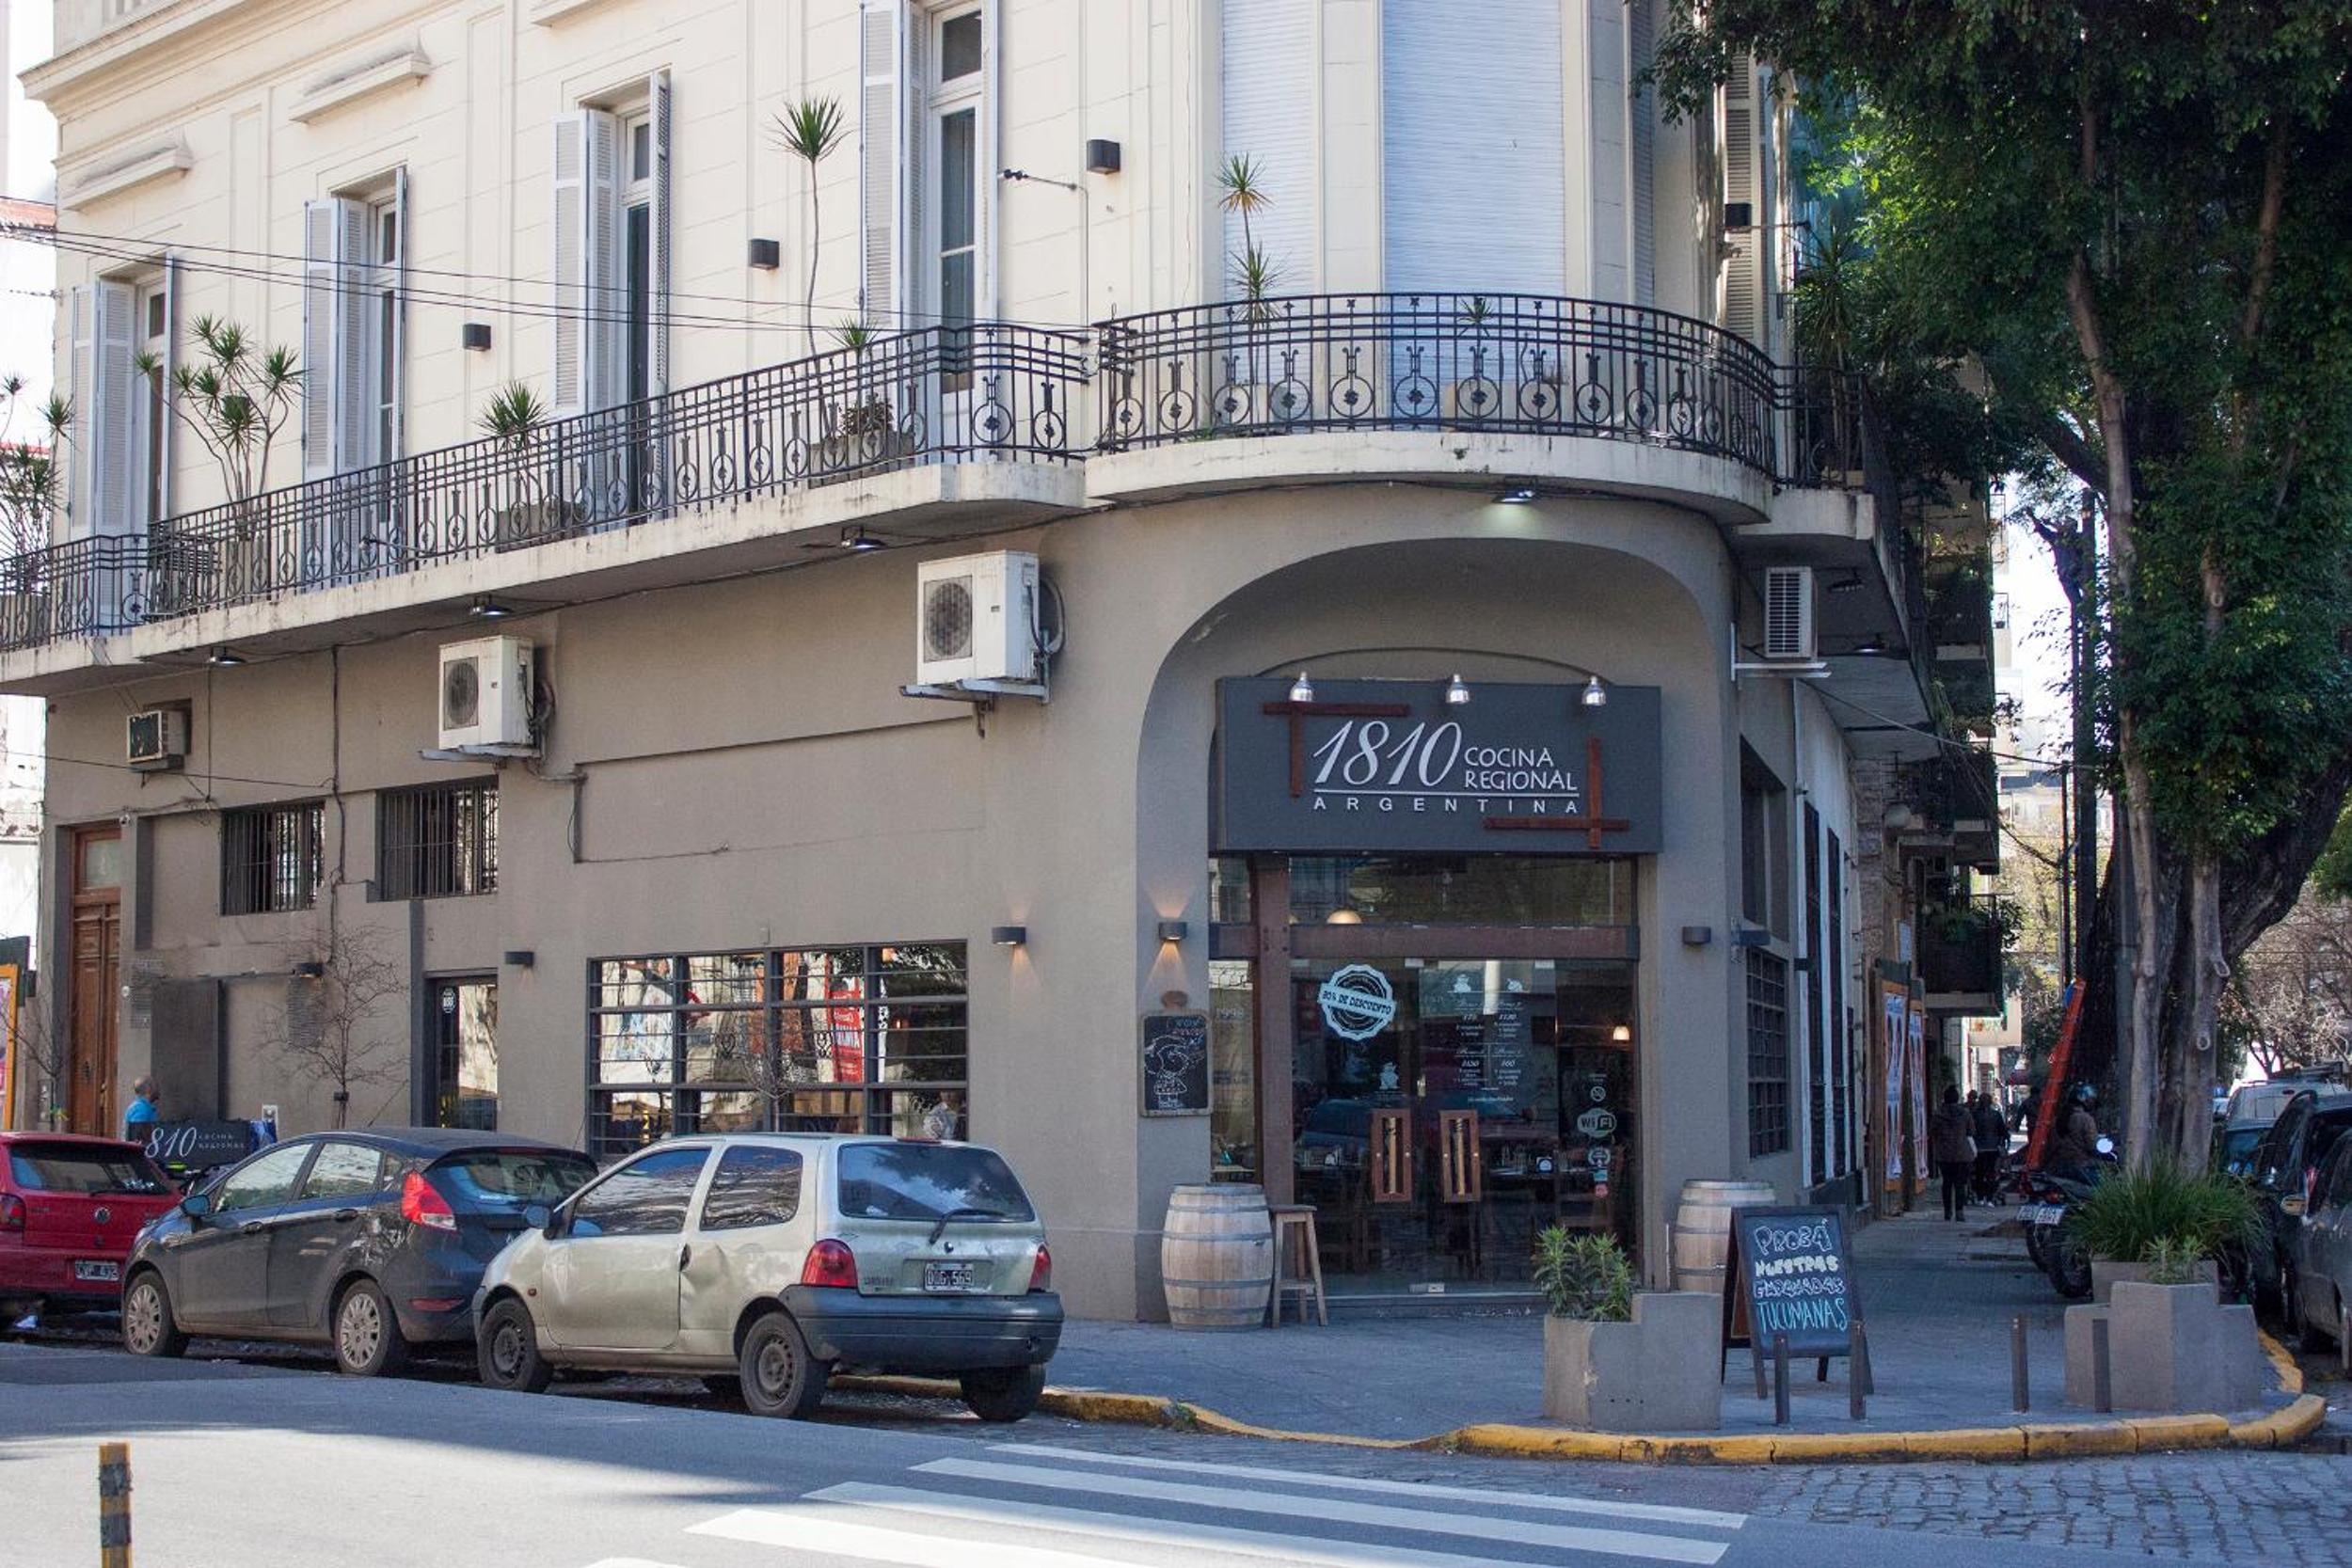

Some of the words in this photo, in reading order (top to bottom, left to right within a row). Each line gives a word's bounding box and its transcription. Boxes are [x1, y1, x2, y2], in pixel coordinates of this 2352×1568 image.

[1313, 721, 1461, 786] 1810
[1464, 747, 1554, 768] COCINA
[1464, 770, 1578, 791] REGIONAL
[1313, 797, 1579, 815] ARGENTINA
[1756, 1256, 1838, 1276] NUESTRAS
[952, 1271, 972, 1286] 569
[1756, 1298, 1849, 1334] TUCUMANAS
